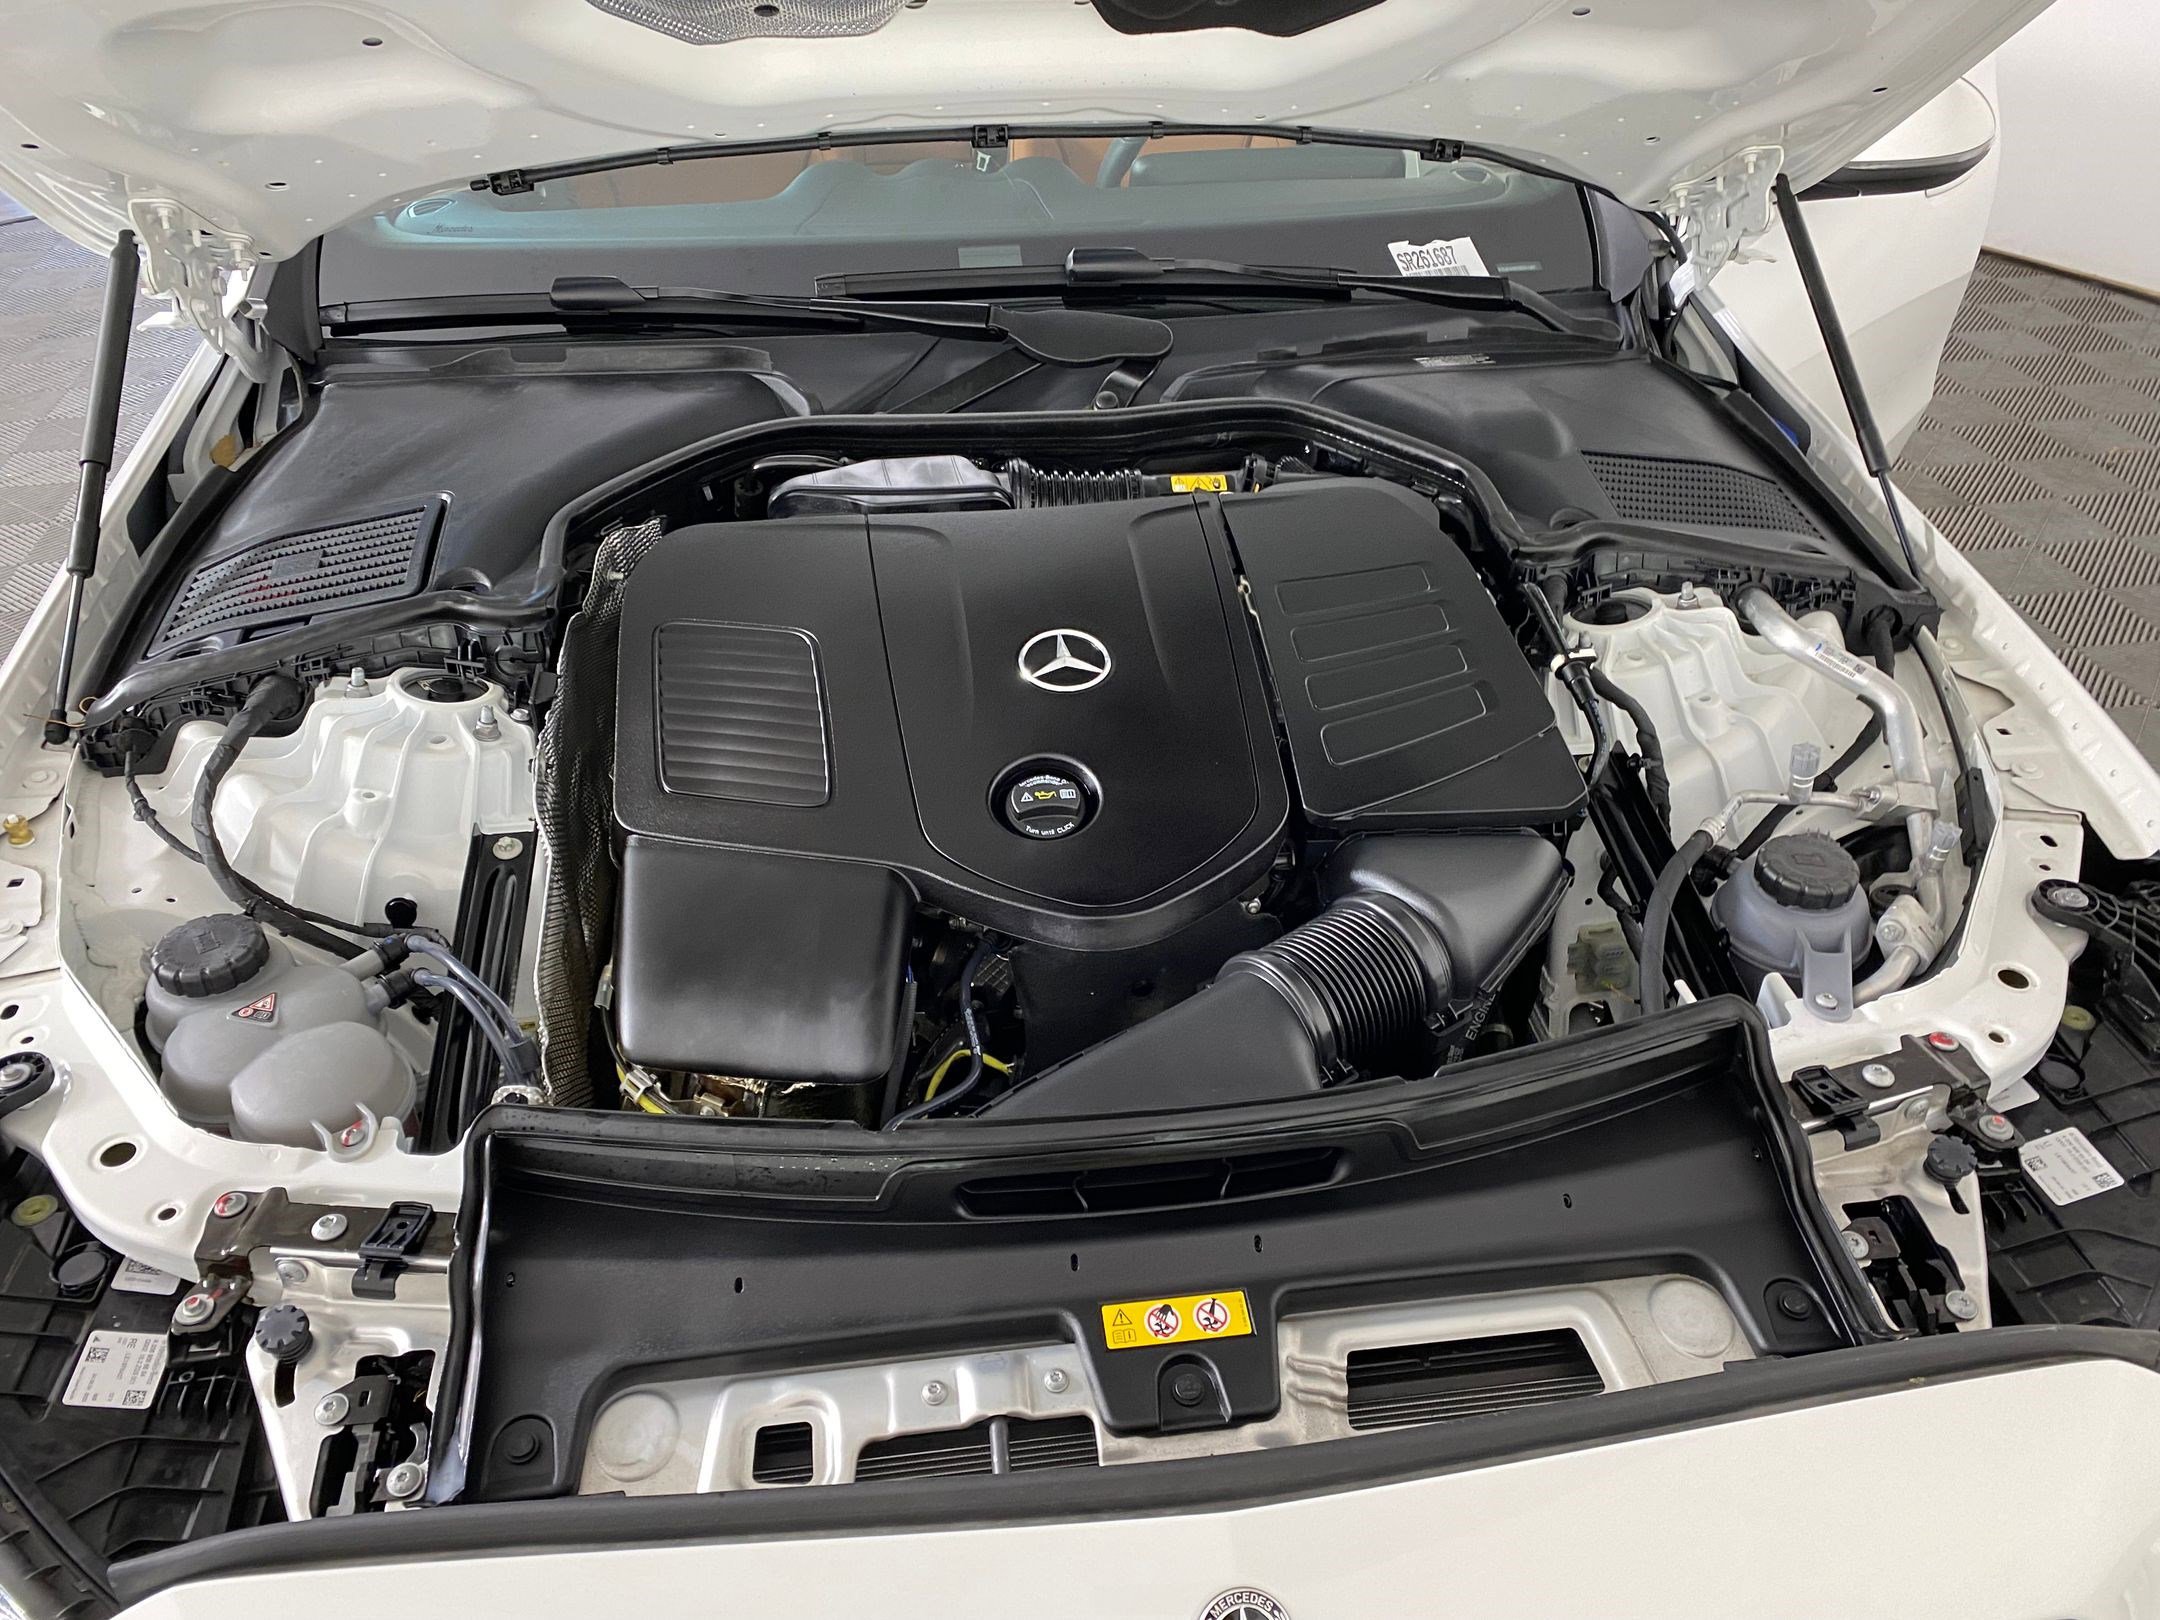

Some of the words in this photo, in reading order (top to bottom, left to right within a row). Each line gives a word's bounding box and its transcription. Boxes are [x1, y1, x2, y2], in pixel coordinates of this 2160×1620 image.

[1396, 246, 1457, 271] SR261687
[1026, 825, 1039, 835] Turn
[1056, 821, 1075, 834] CLICK
[1209, 1592, 1274, 1618] MERCEDES
